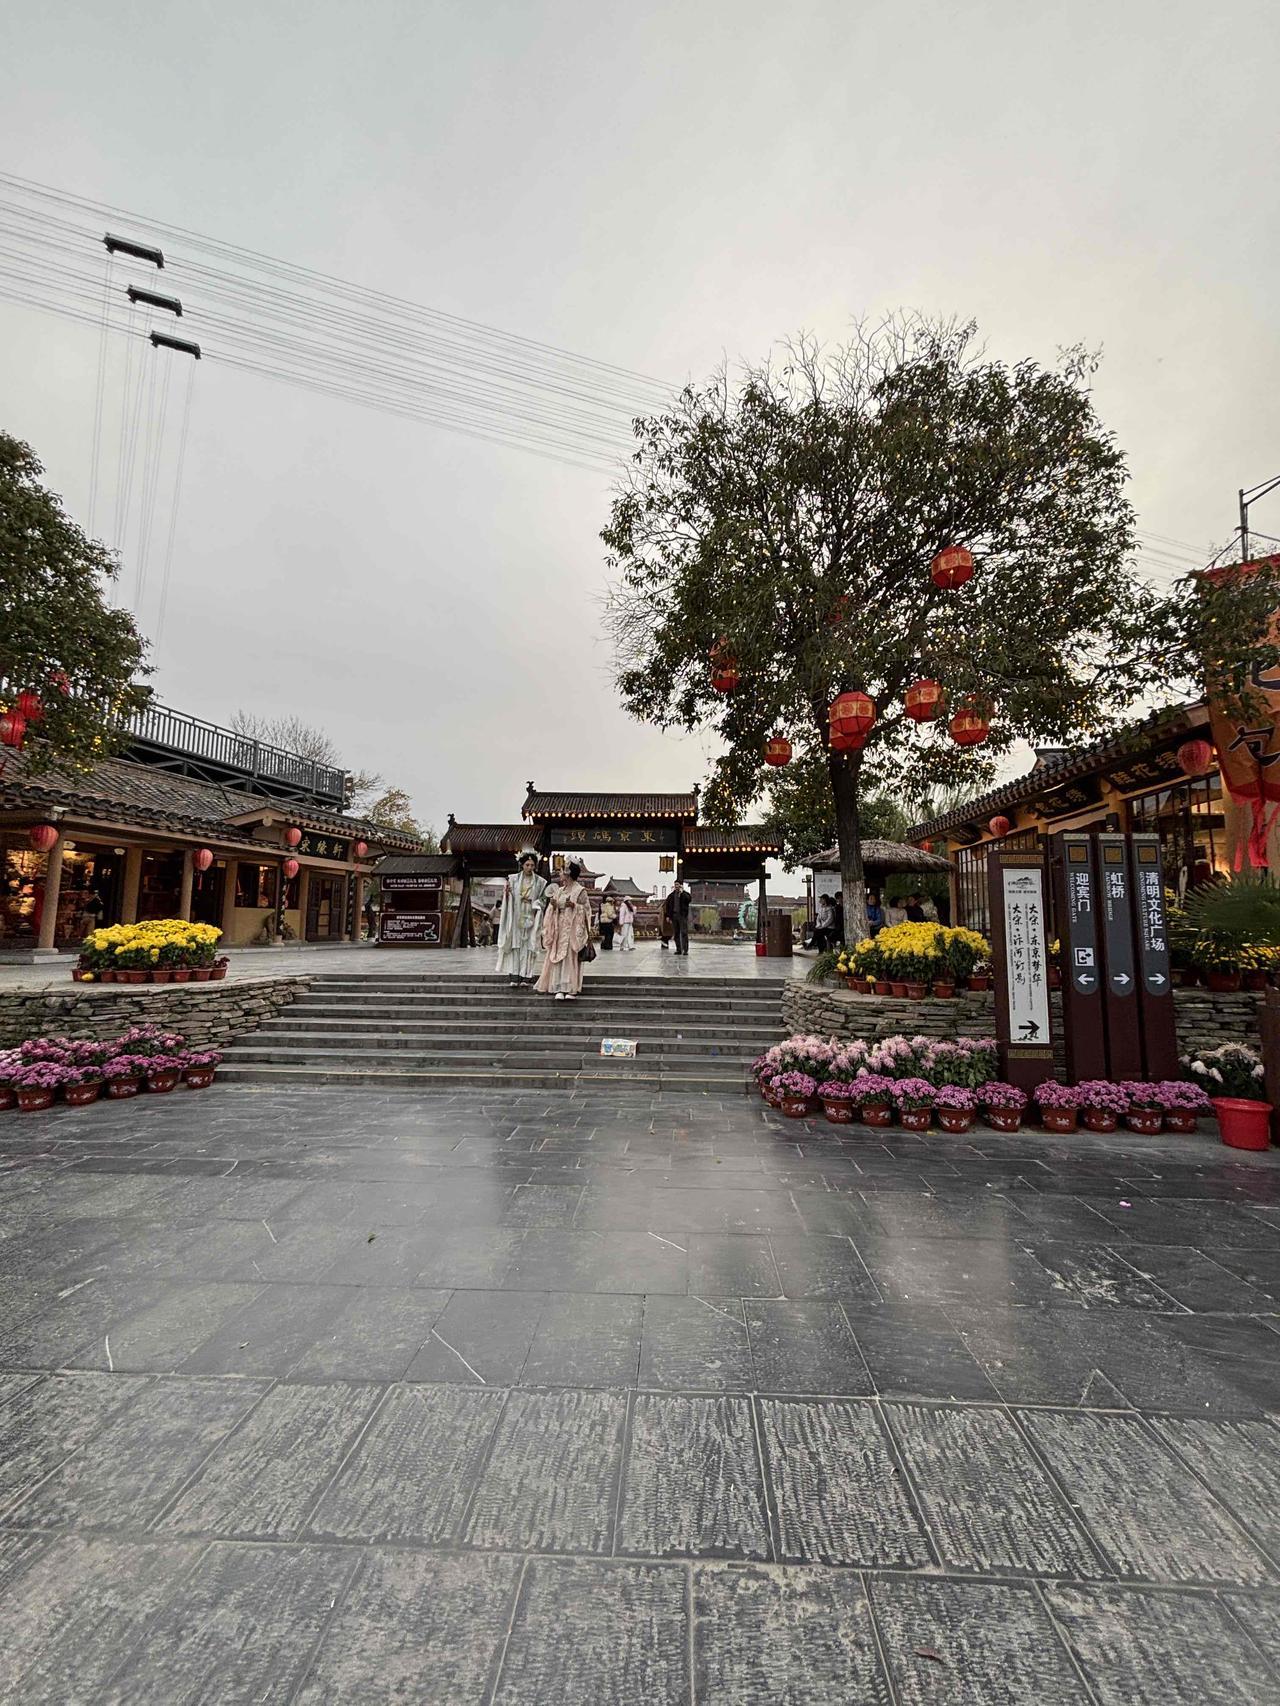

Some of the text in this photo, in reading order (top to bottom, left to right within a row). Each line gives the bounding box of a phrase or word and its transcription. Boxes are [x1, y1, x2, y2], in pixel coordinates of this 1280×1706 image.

[1076, 872, 1090, 911] 迎宾门
[1110, 872, 1125, 898] 虹桥
[1145, 872, 1165, 951] 清明文化广场
